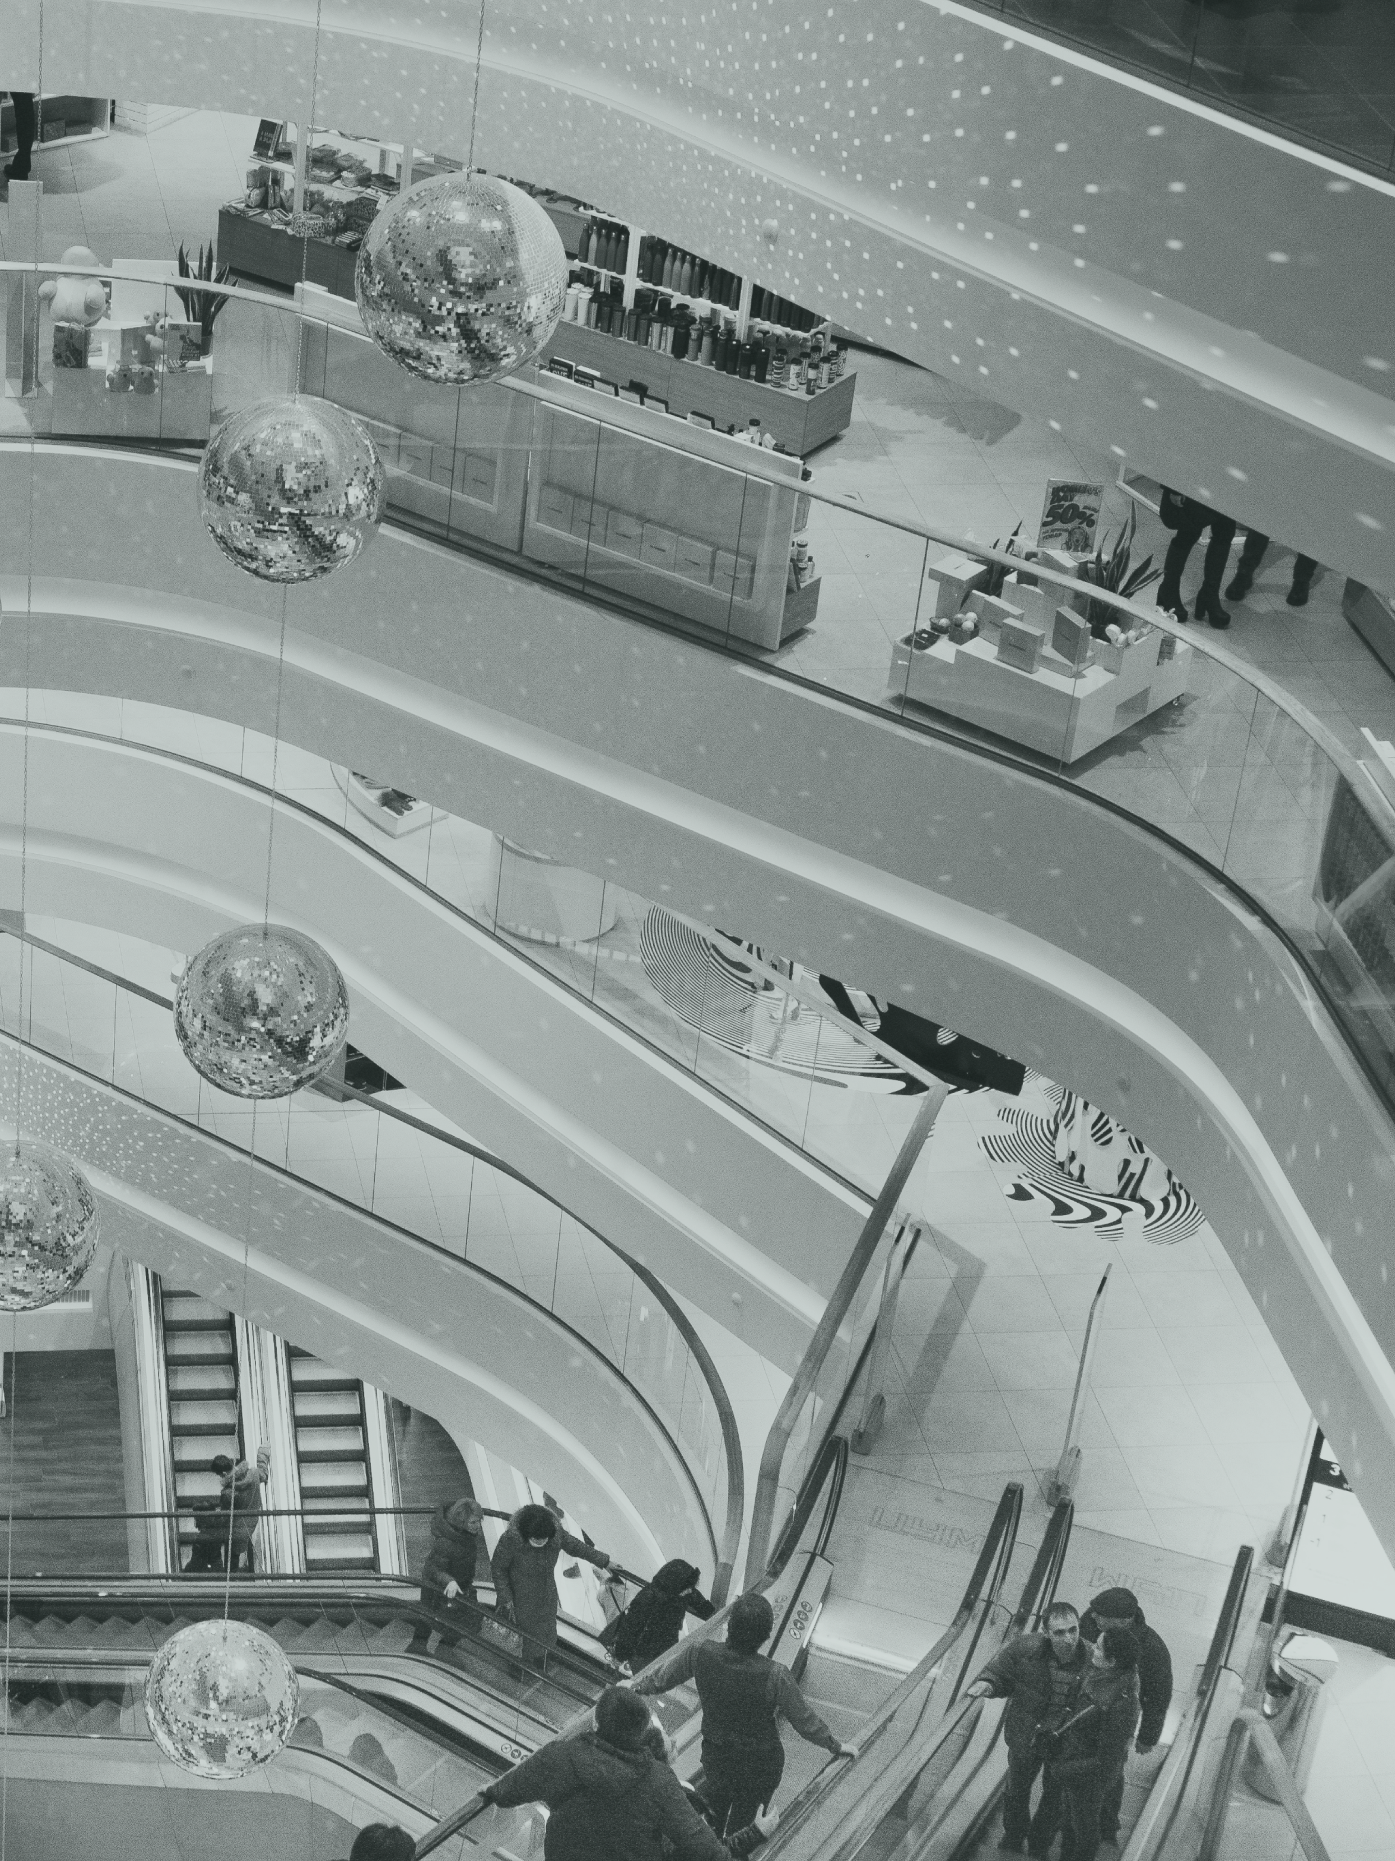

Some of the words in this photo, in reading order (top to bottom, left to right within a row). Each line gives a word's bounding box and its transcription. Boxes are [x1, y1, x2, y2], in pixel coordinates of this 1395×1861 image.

[1042, 503, 1095, 528] 50%
[1329, 1463, 1341, 1476] 3
[1325, 1489, 1334, 1501] 2
[1322, 1514, 1326, 1524] 1
